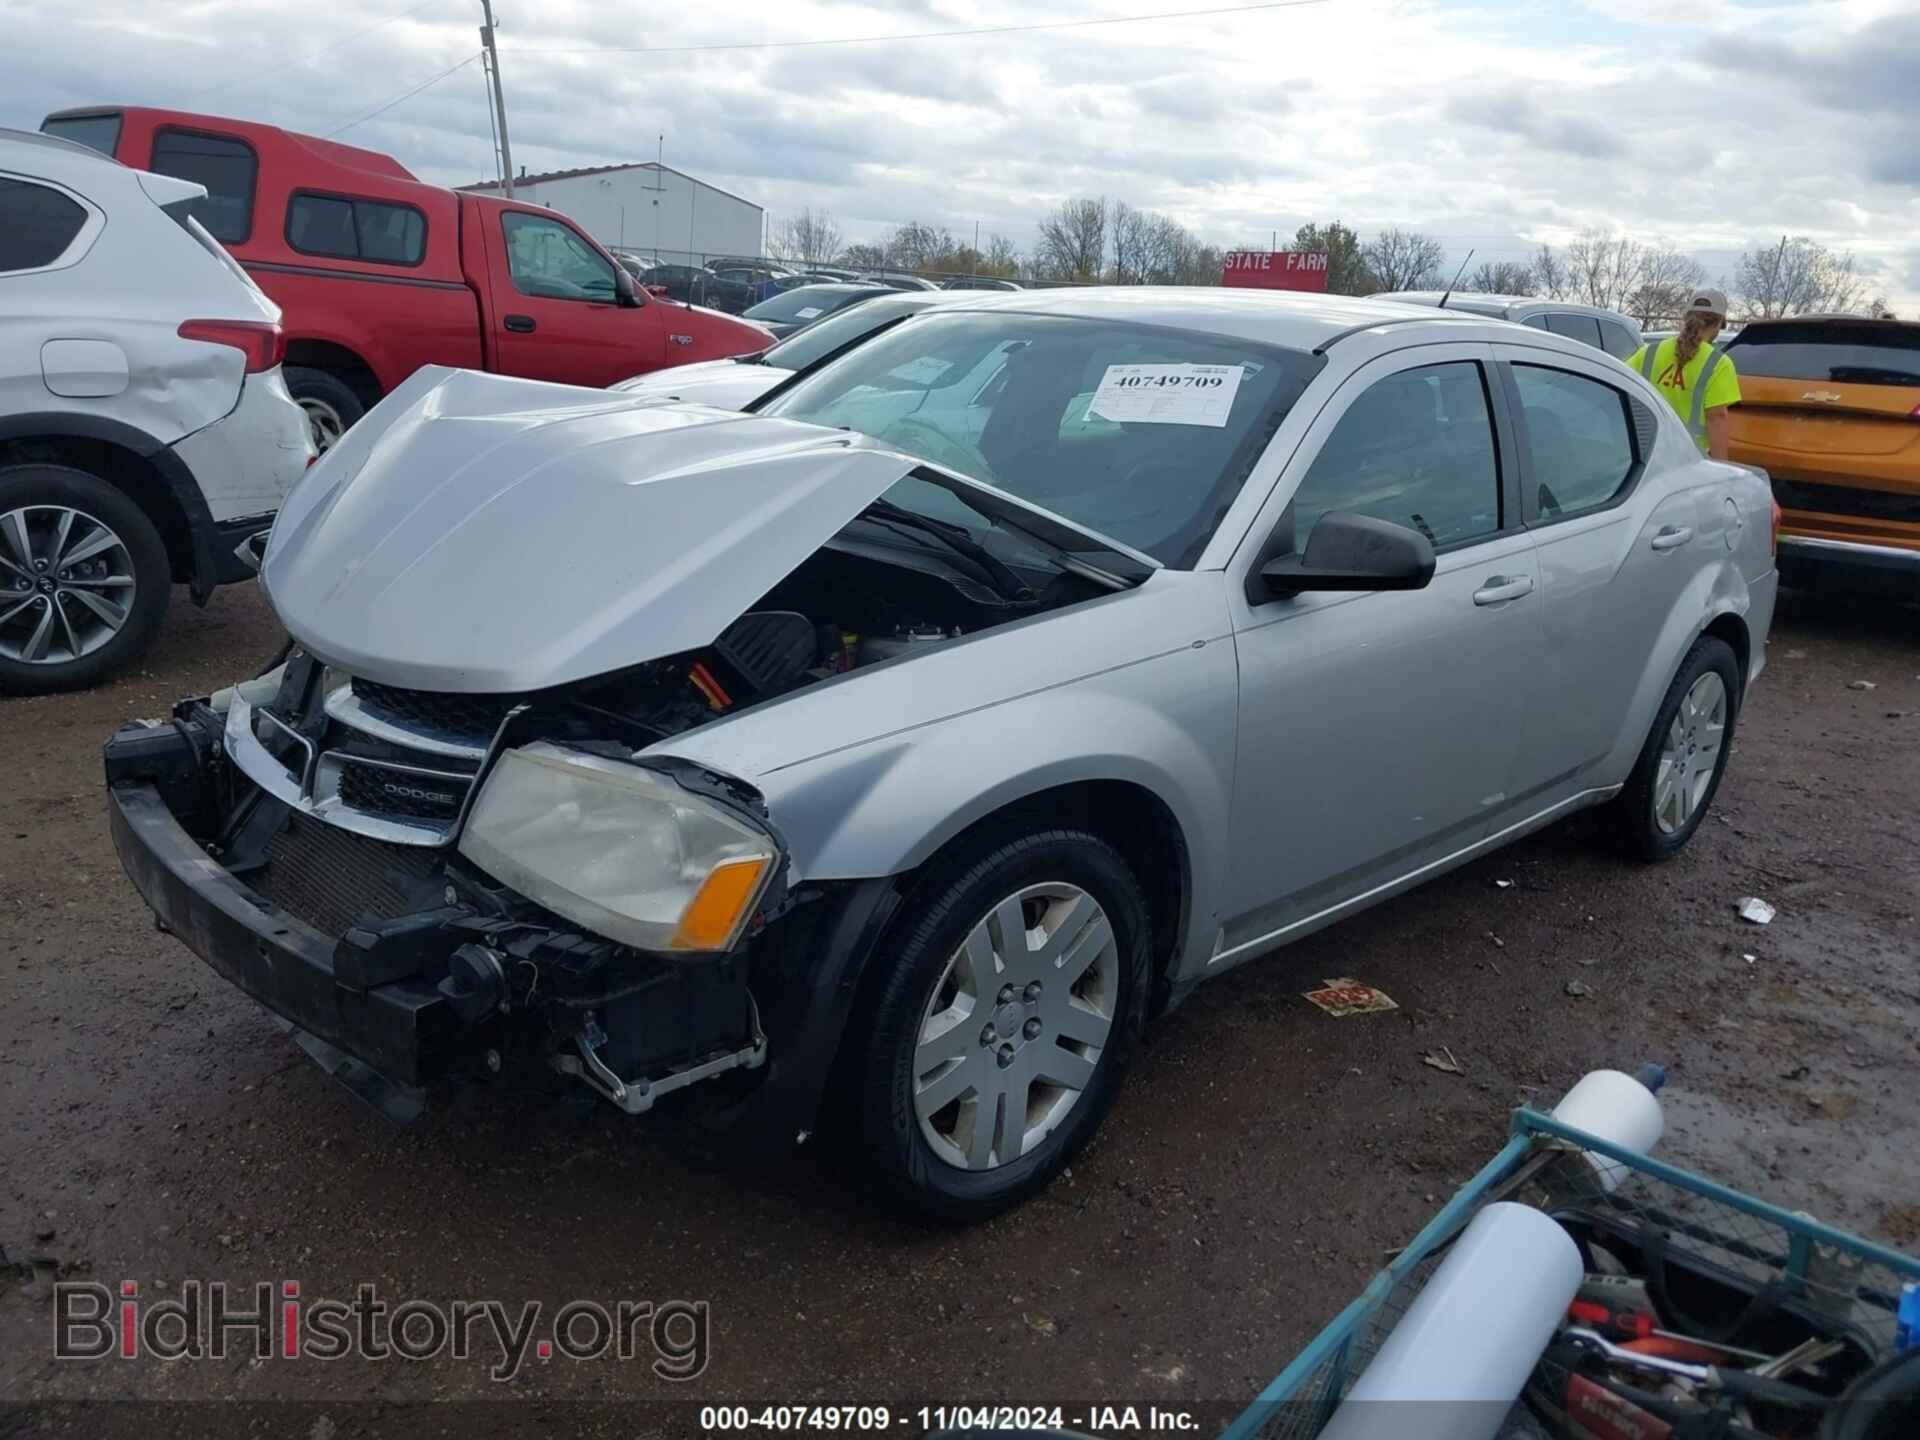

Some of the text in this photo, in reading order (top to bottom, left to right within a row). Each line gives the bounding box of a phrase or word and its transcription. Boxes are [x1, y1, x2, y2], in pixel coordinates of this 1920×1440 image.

[1224, 253, 1328, 271] STATE FARM
[1113, 375, 1223, 388] 40749709
[384, 783, 456, 805] DODGE
